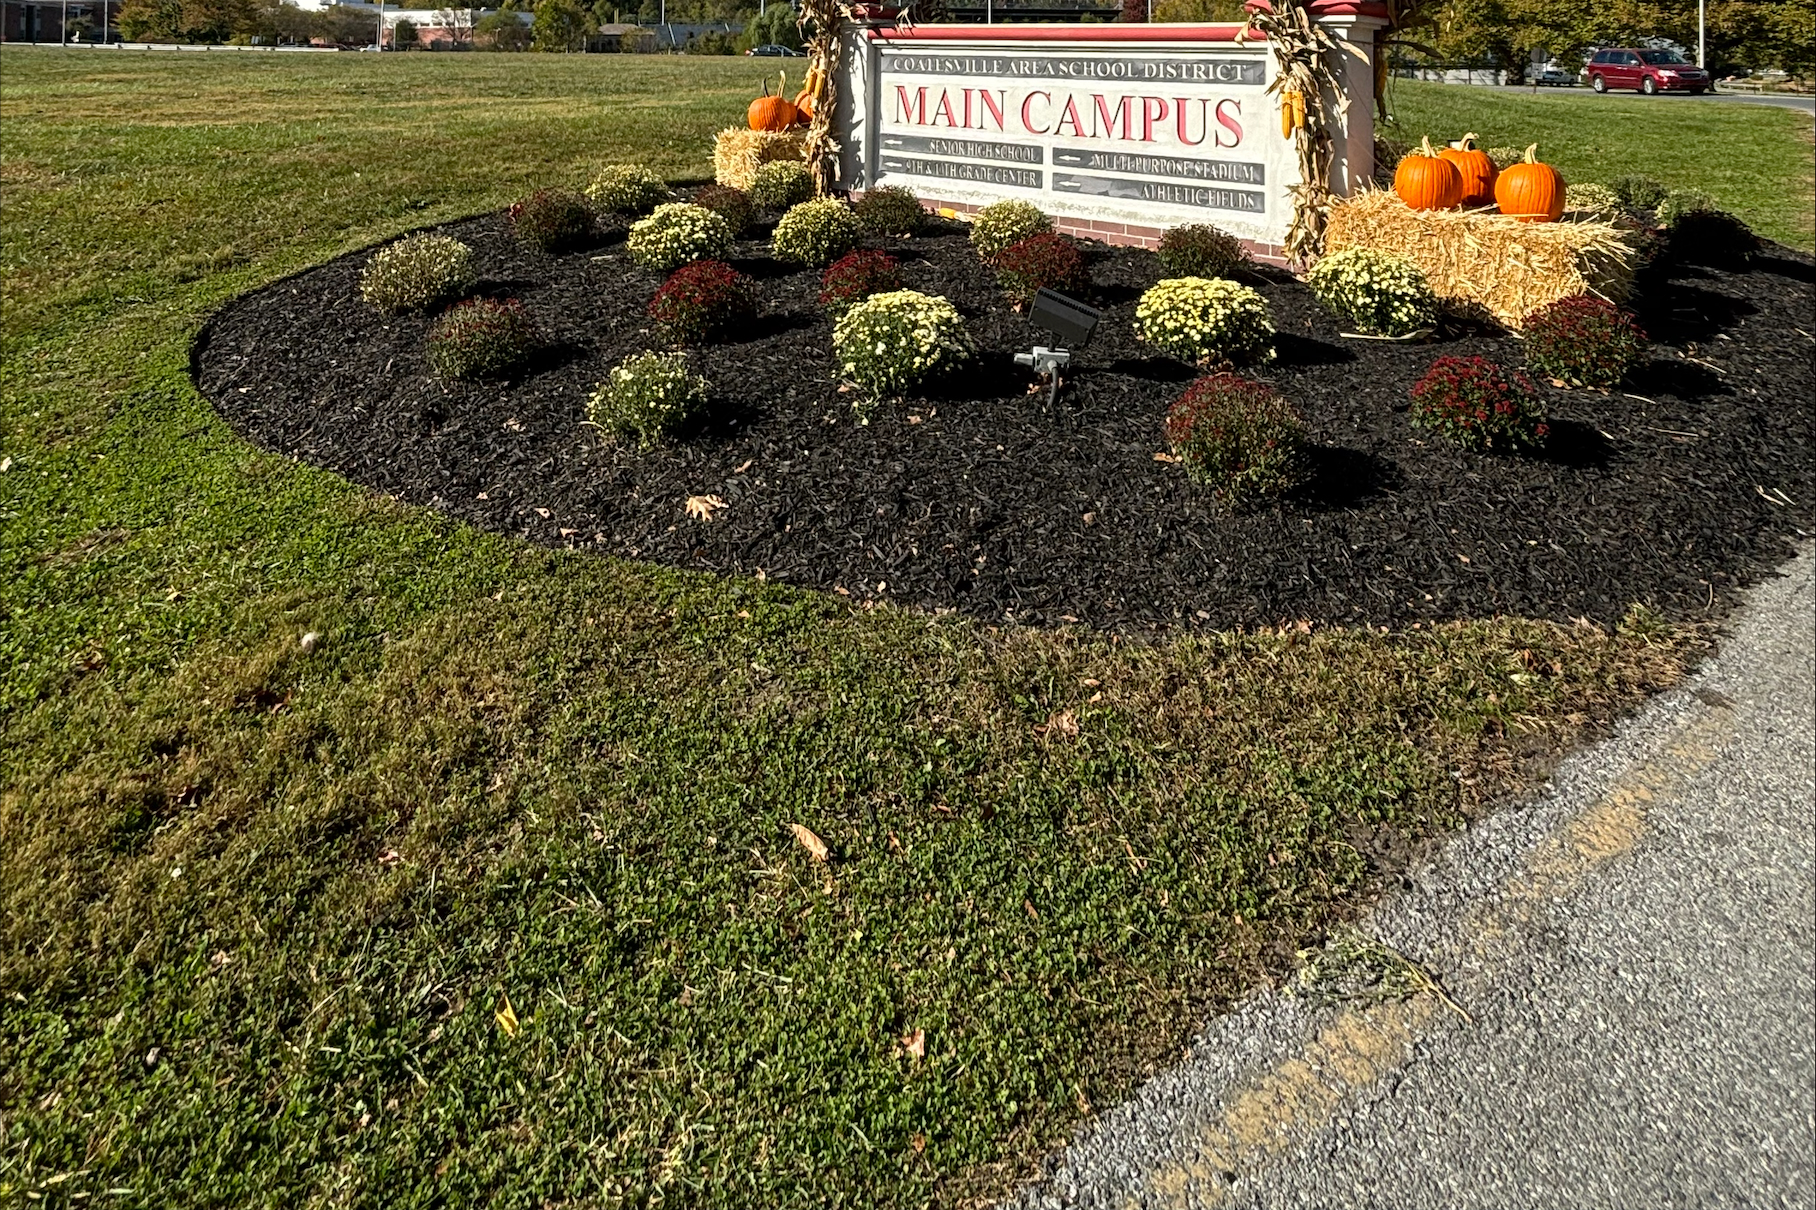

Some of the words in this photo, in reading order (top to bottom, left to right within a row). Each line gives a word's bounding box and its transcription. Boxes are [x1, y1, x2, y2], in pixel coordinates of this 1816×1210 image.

[893, 58, 1003, 74] COATESVILLE
[1006, 63, 1055, 75] AREA
[1058, 61, 1138, 78] SCHOOL
[1143, 63, 1247, 81] DISTRICT
[894, 85, 1007, 132] MAIN
[1021, 90, 1244, 148] CAMPUS
[929, 139, 965, 156] SENIOR
[967, 141, 993, 158] HIGH
[995, 144, 1037, 161] SCHOOL
[906, 159, 923, 174] 9TH
[925, 163, 932, 174] &
[959, 164, 992, 181] GRADE
[995, 168, 1037, 186] CENTER
[1194, 162, 1255, 182] STADIUM
[1140, 184, 1203, 205] ATHLETIC
[1208, 191, 1255, 209] FIELDS
